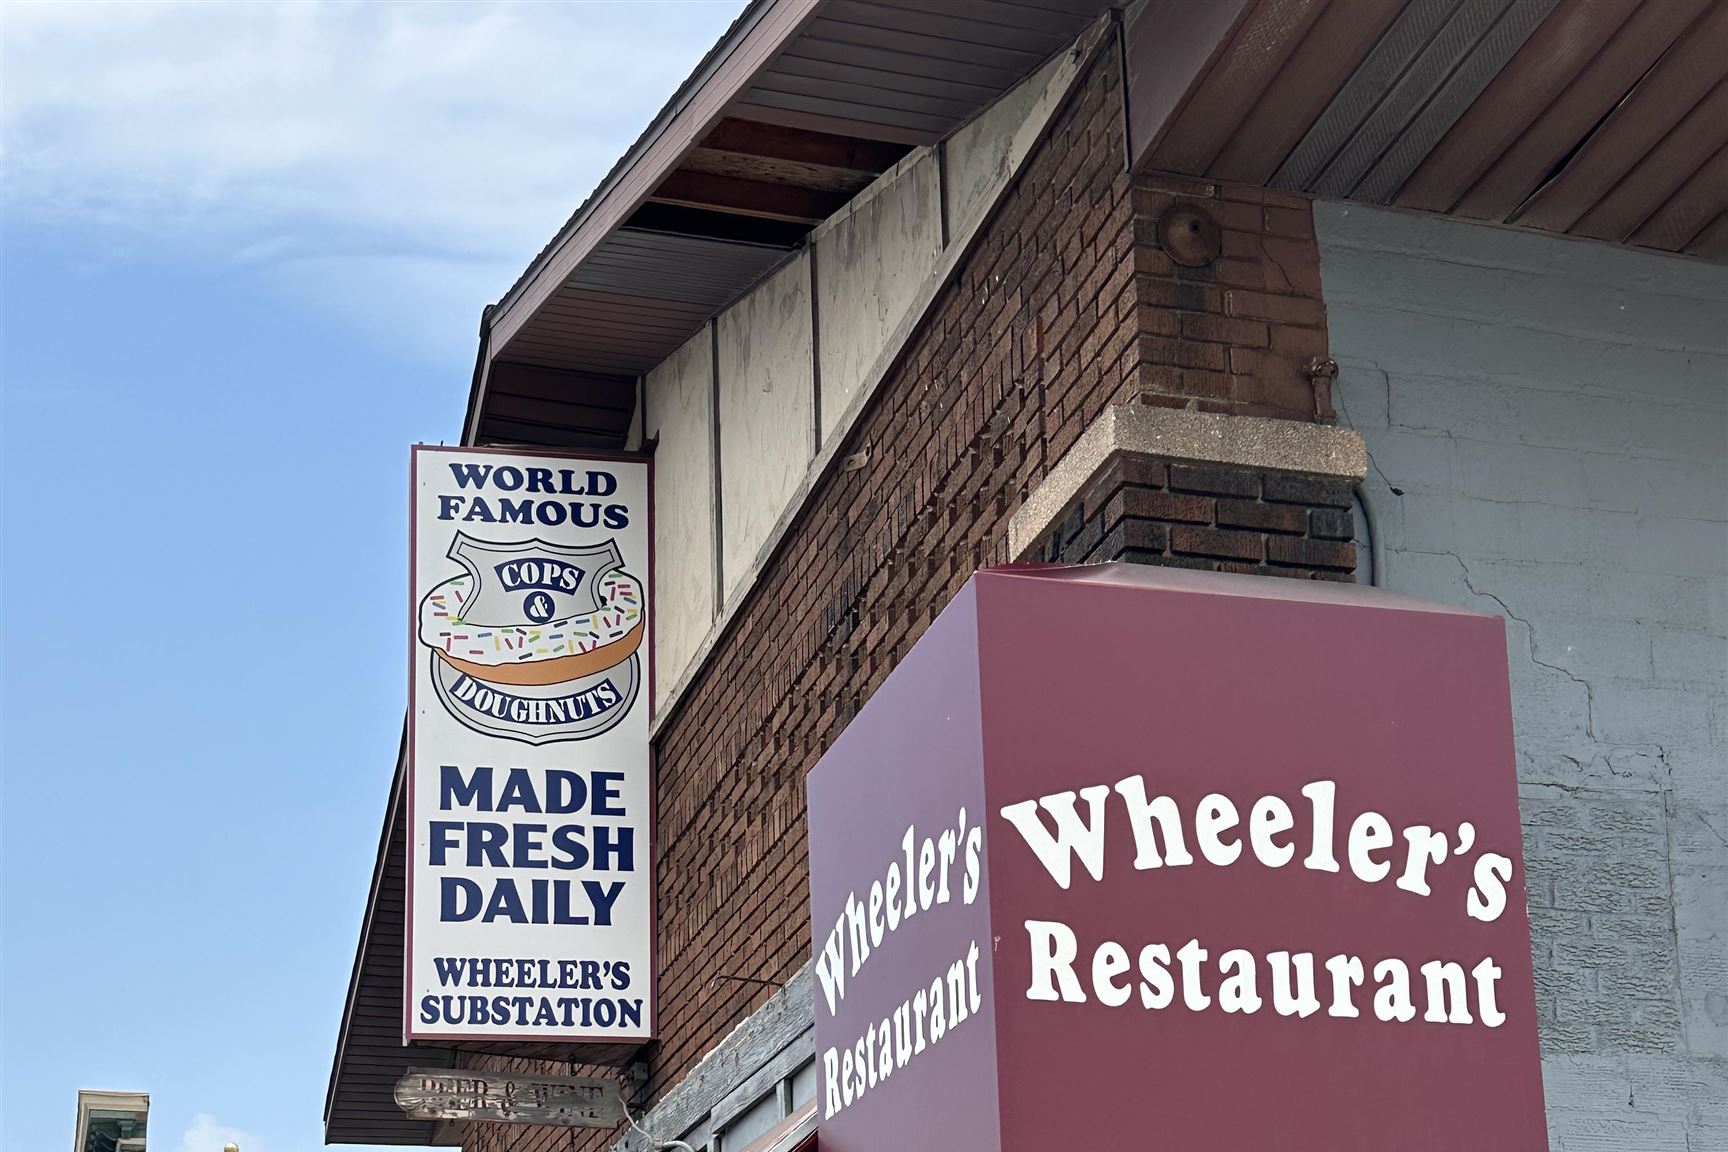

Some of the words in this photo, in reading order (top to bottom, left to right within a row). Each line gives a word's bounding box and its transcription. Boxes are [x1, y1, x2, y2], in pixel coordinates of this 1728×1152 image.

[448, 463, 618, 496] WORLD
[437, 495, 629, 530] FAMOUS
[500, 561, 579, 590] COPS
[529, 595, 550, 618] &
[453, 676, 616, 723] DOUGHNUTS
[439, 766, 626, 816] MADE
[428, 820, 635, 872] FRESH
[1000, 774, 1513, 922] Wheeler's
[439, 876, 627, 926] DAILY
[815, 806, 982, 1016] Wheeler's
[433, 957, 630, 991] WHEELER'S
[1024, 919, 1506, 1028] Restaurant
[420, 994, 643, 1028] SUBSTATION
[823, 939, 981, 1121] Restaurant
